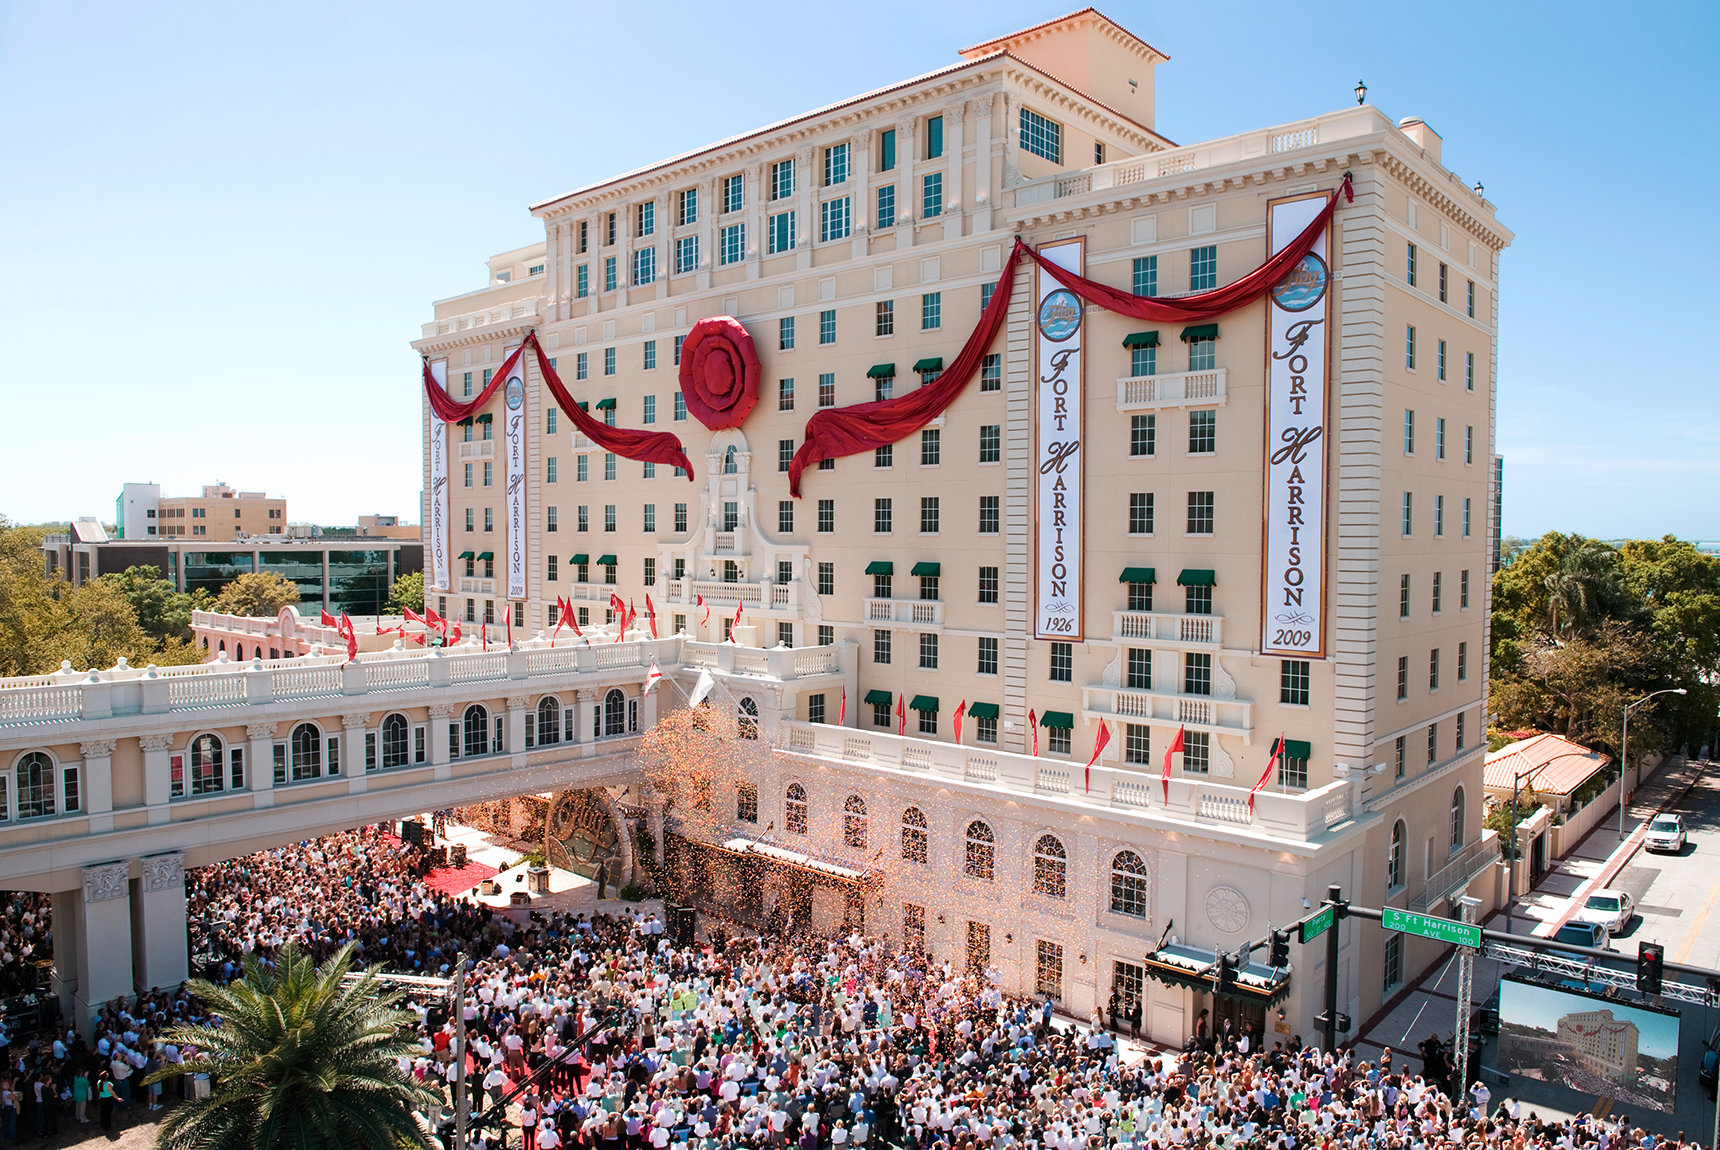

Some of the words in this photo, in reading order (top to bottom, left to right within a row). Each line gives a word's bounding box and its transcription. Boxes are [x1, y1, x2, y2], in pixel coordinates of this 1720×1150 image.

[511, 586, 523, 595] 2009
[1045, 617, 1074, 632] 1926
[1273, 629, 1311, 646] 2009
[1393, 912, 1400, 921] S
[1406, 915, 1418, 925] Ft
[1423, 918, 1470, 936] Harrison
[1389, 921, 1406, 931] 200
[1423, 929, 1440, 938] AVE
[1459, 937, 1474, 946] 100
